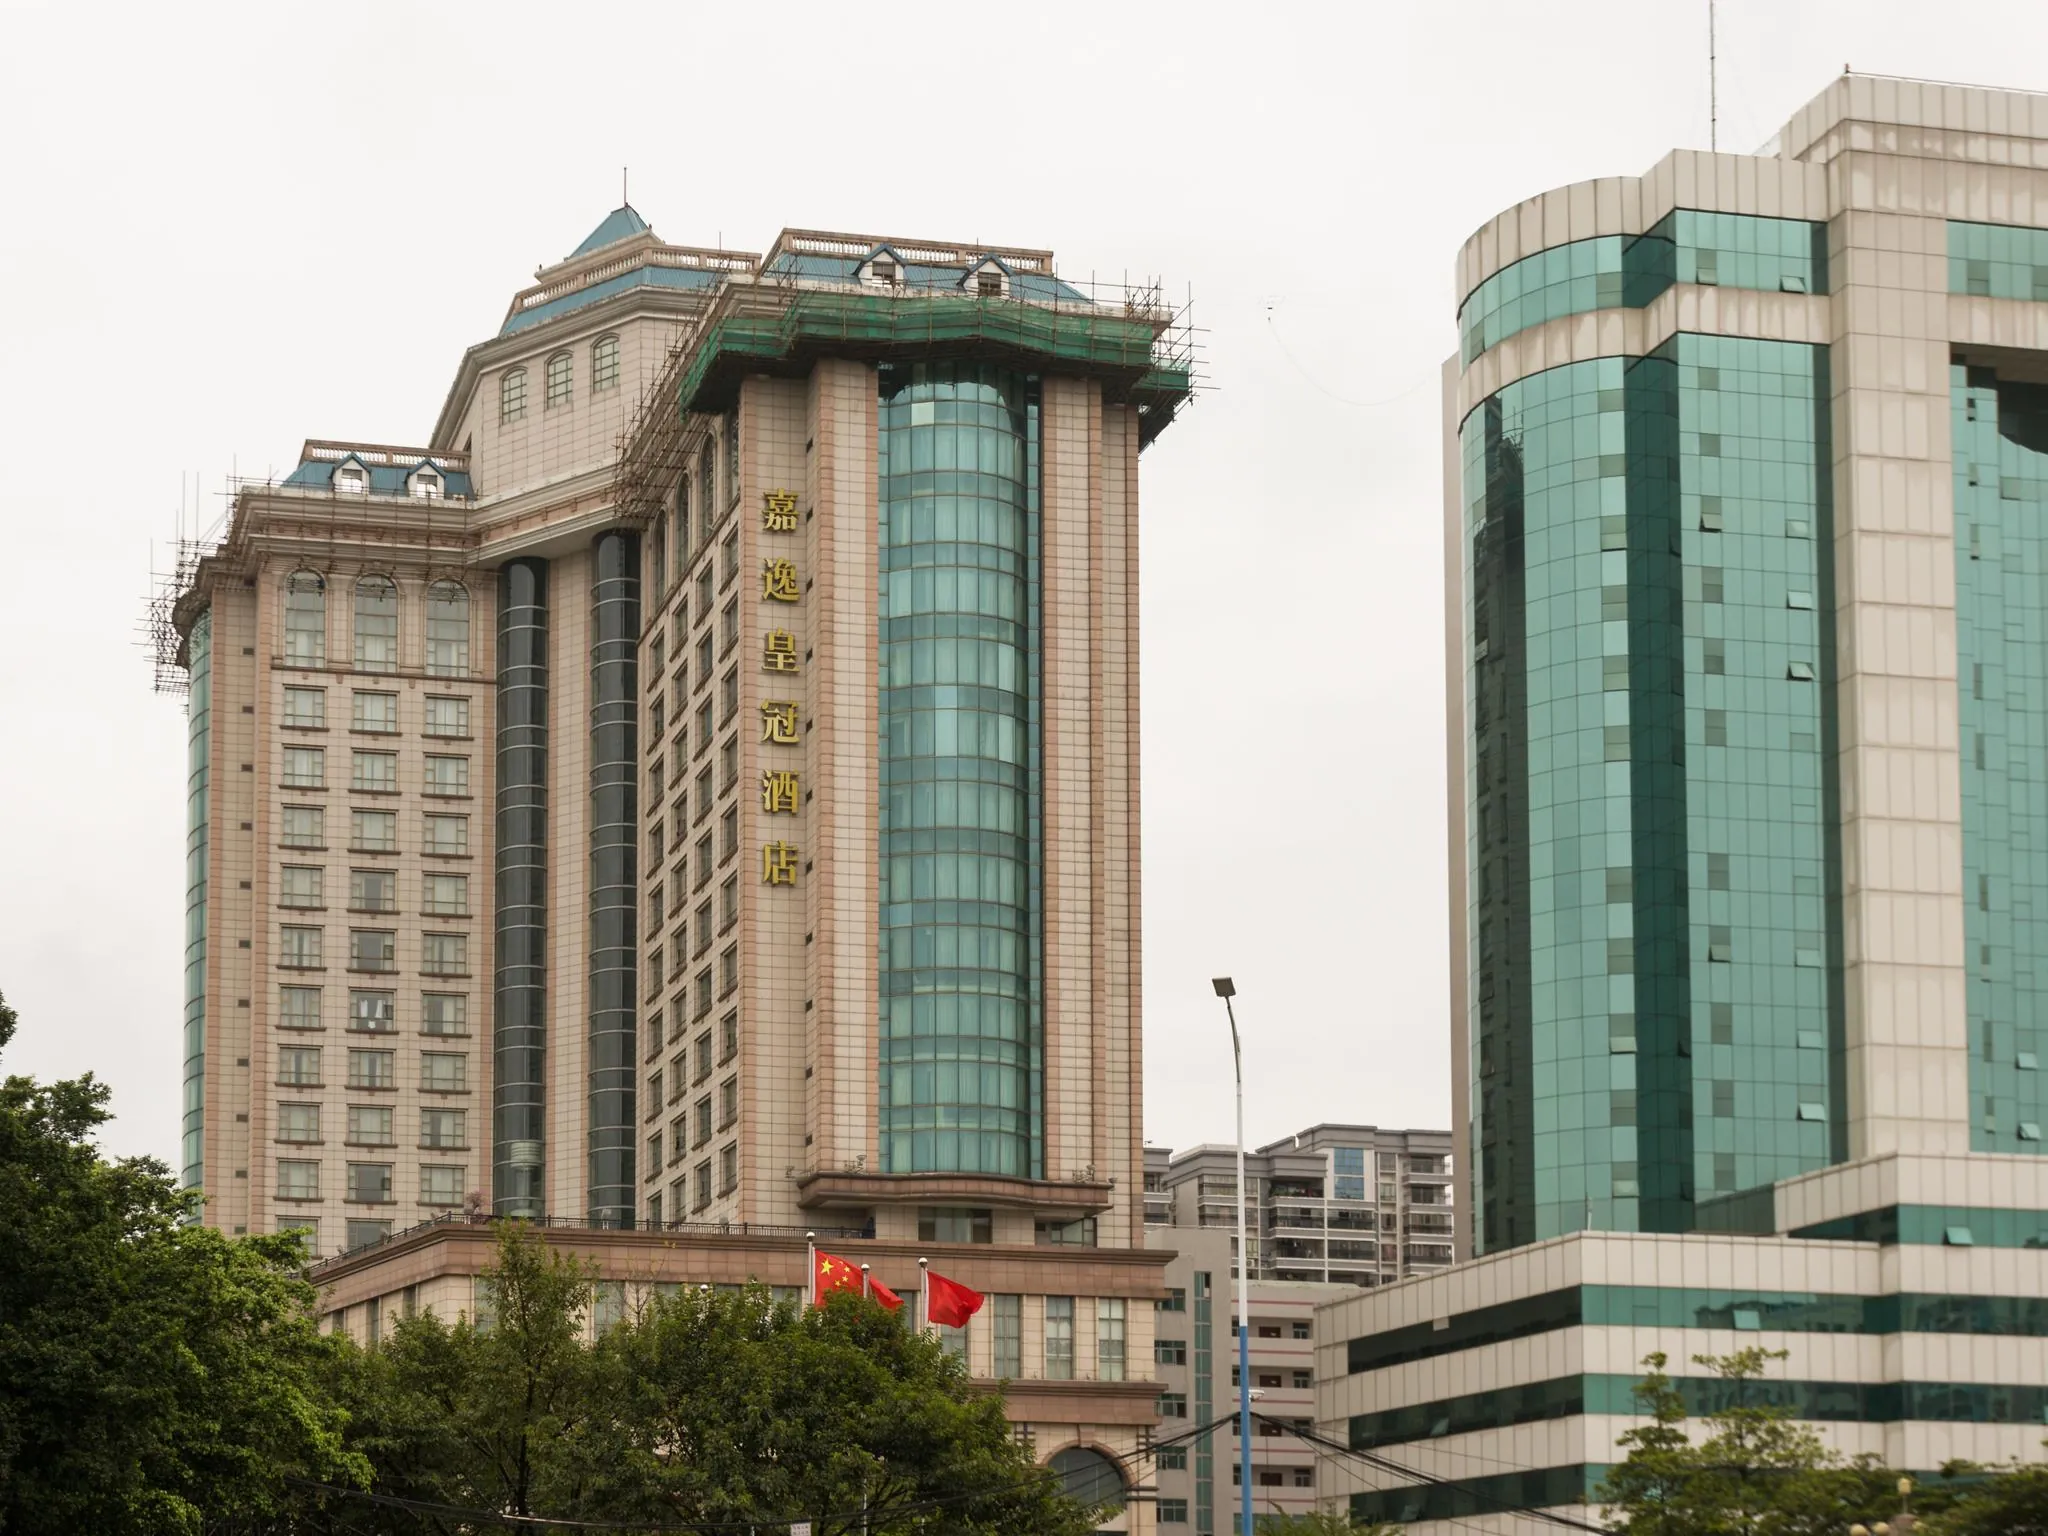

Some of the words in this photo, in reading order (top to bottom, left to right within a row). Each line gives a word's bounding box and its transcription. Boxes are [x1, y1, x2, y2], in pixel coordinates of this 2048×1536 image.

[761, 488, 800, 886] 嘉逸皇冠酒店
